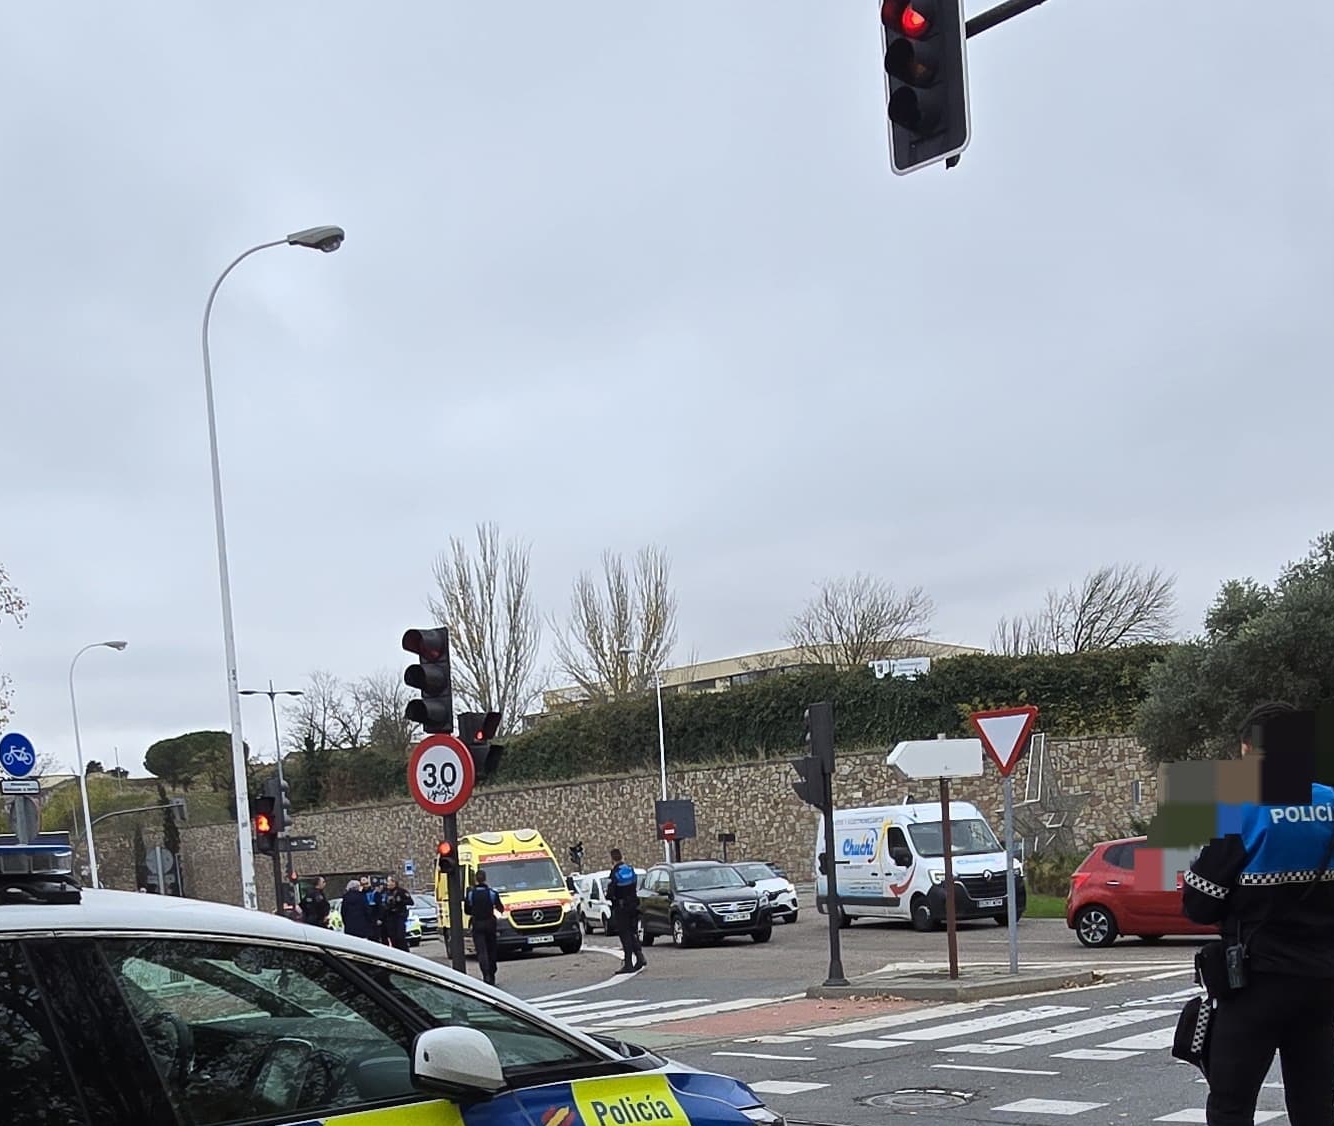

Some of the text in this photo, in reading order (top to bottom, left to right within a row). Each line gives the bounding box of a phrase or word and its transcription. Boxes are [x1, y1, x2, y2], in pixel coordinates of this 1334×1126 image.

[422, 762, 457, 788] 30
[842, 837, 875, 857] Chuchi
[590, 1094, 674, 1126] Policía
